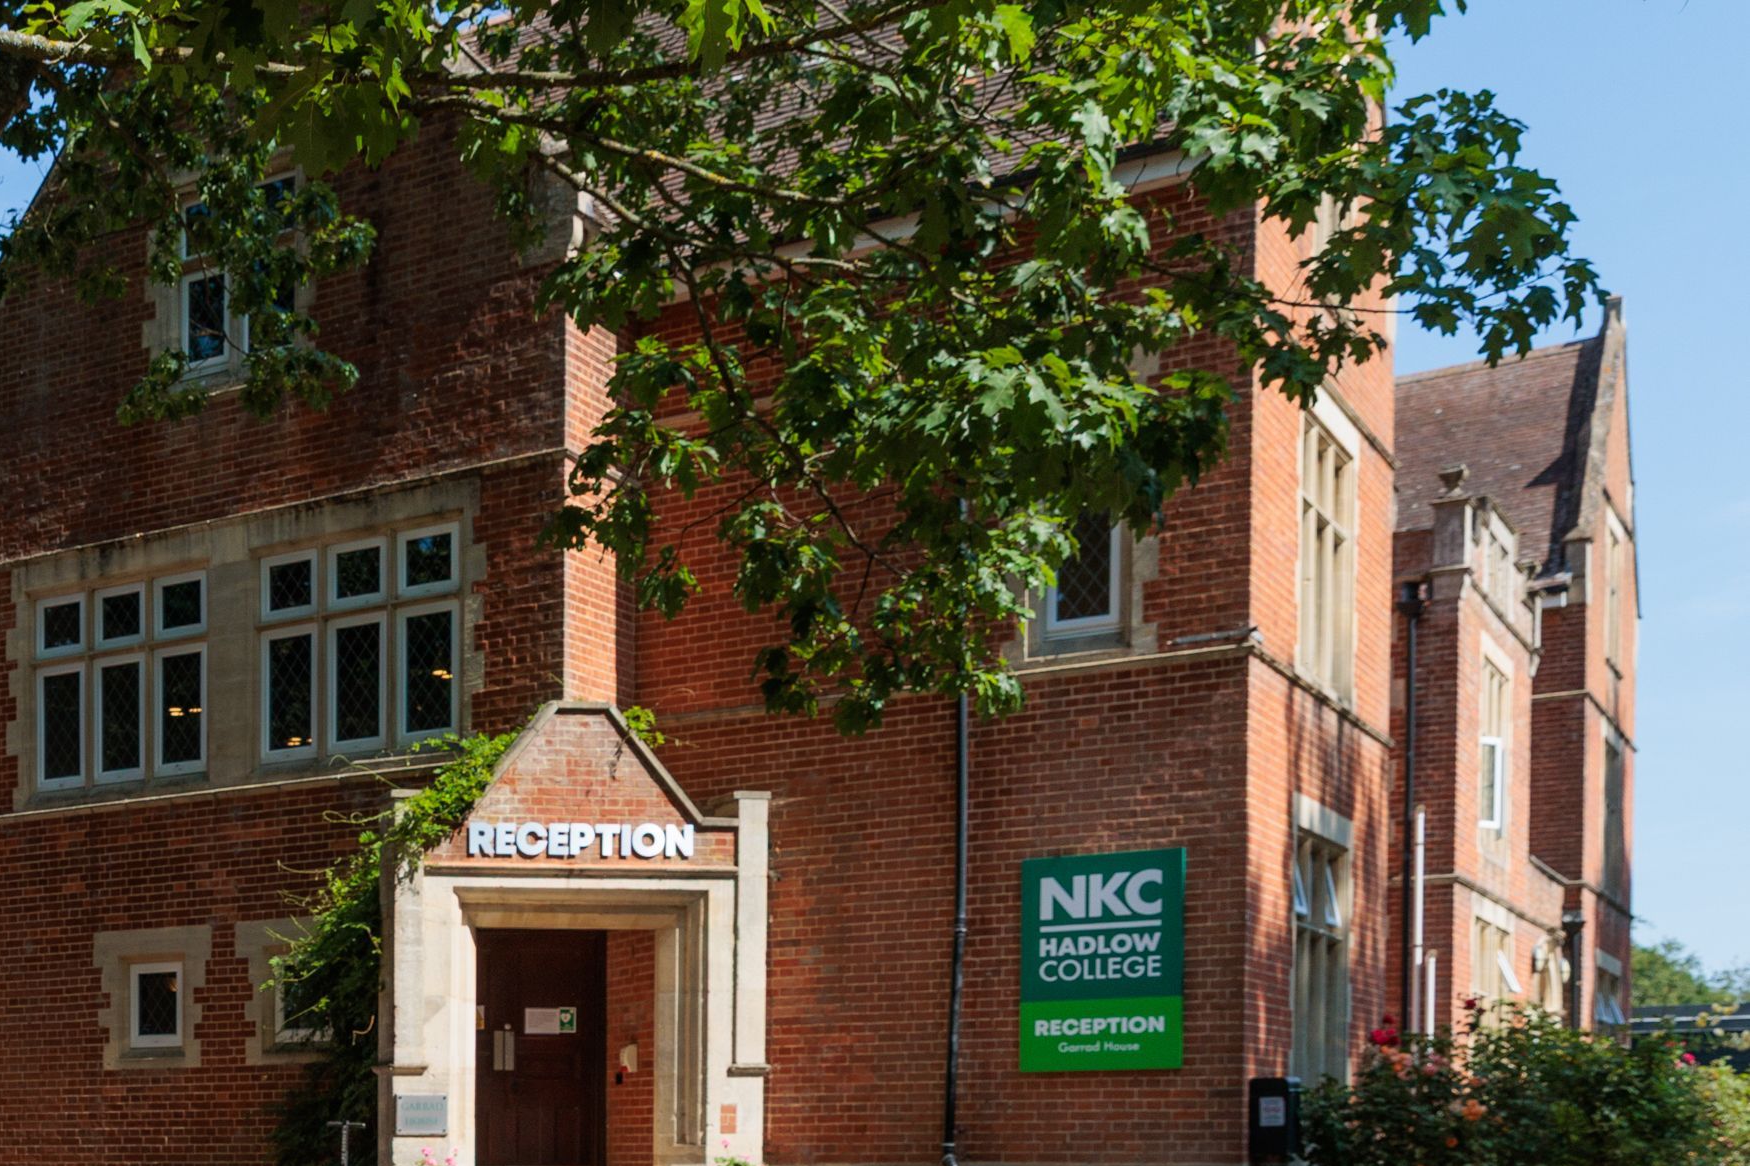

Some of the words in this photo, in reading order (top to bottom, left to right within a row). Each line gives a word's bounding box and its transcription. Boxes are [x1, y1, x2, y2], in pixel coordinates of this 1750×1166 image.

[468, 821, 695, 859] RECEPTION
[1039, 868, 1163, 921] NKC
[1038, 931, 1162, 958] HADLOW
[1038, 955, 1162, 982] COLLEGE
[1034, 1015, 1165, 1037] RECEPTION
[1057, 1040, 1101, 1053] Garrad
[1103, 1040, 1140, 1052] House
